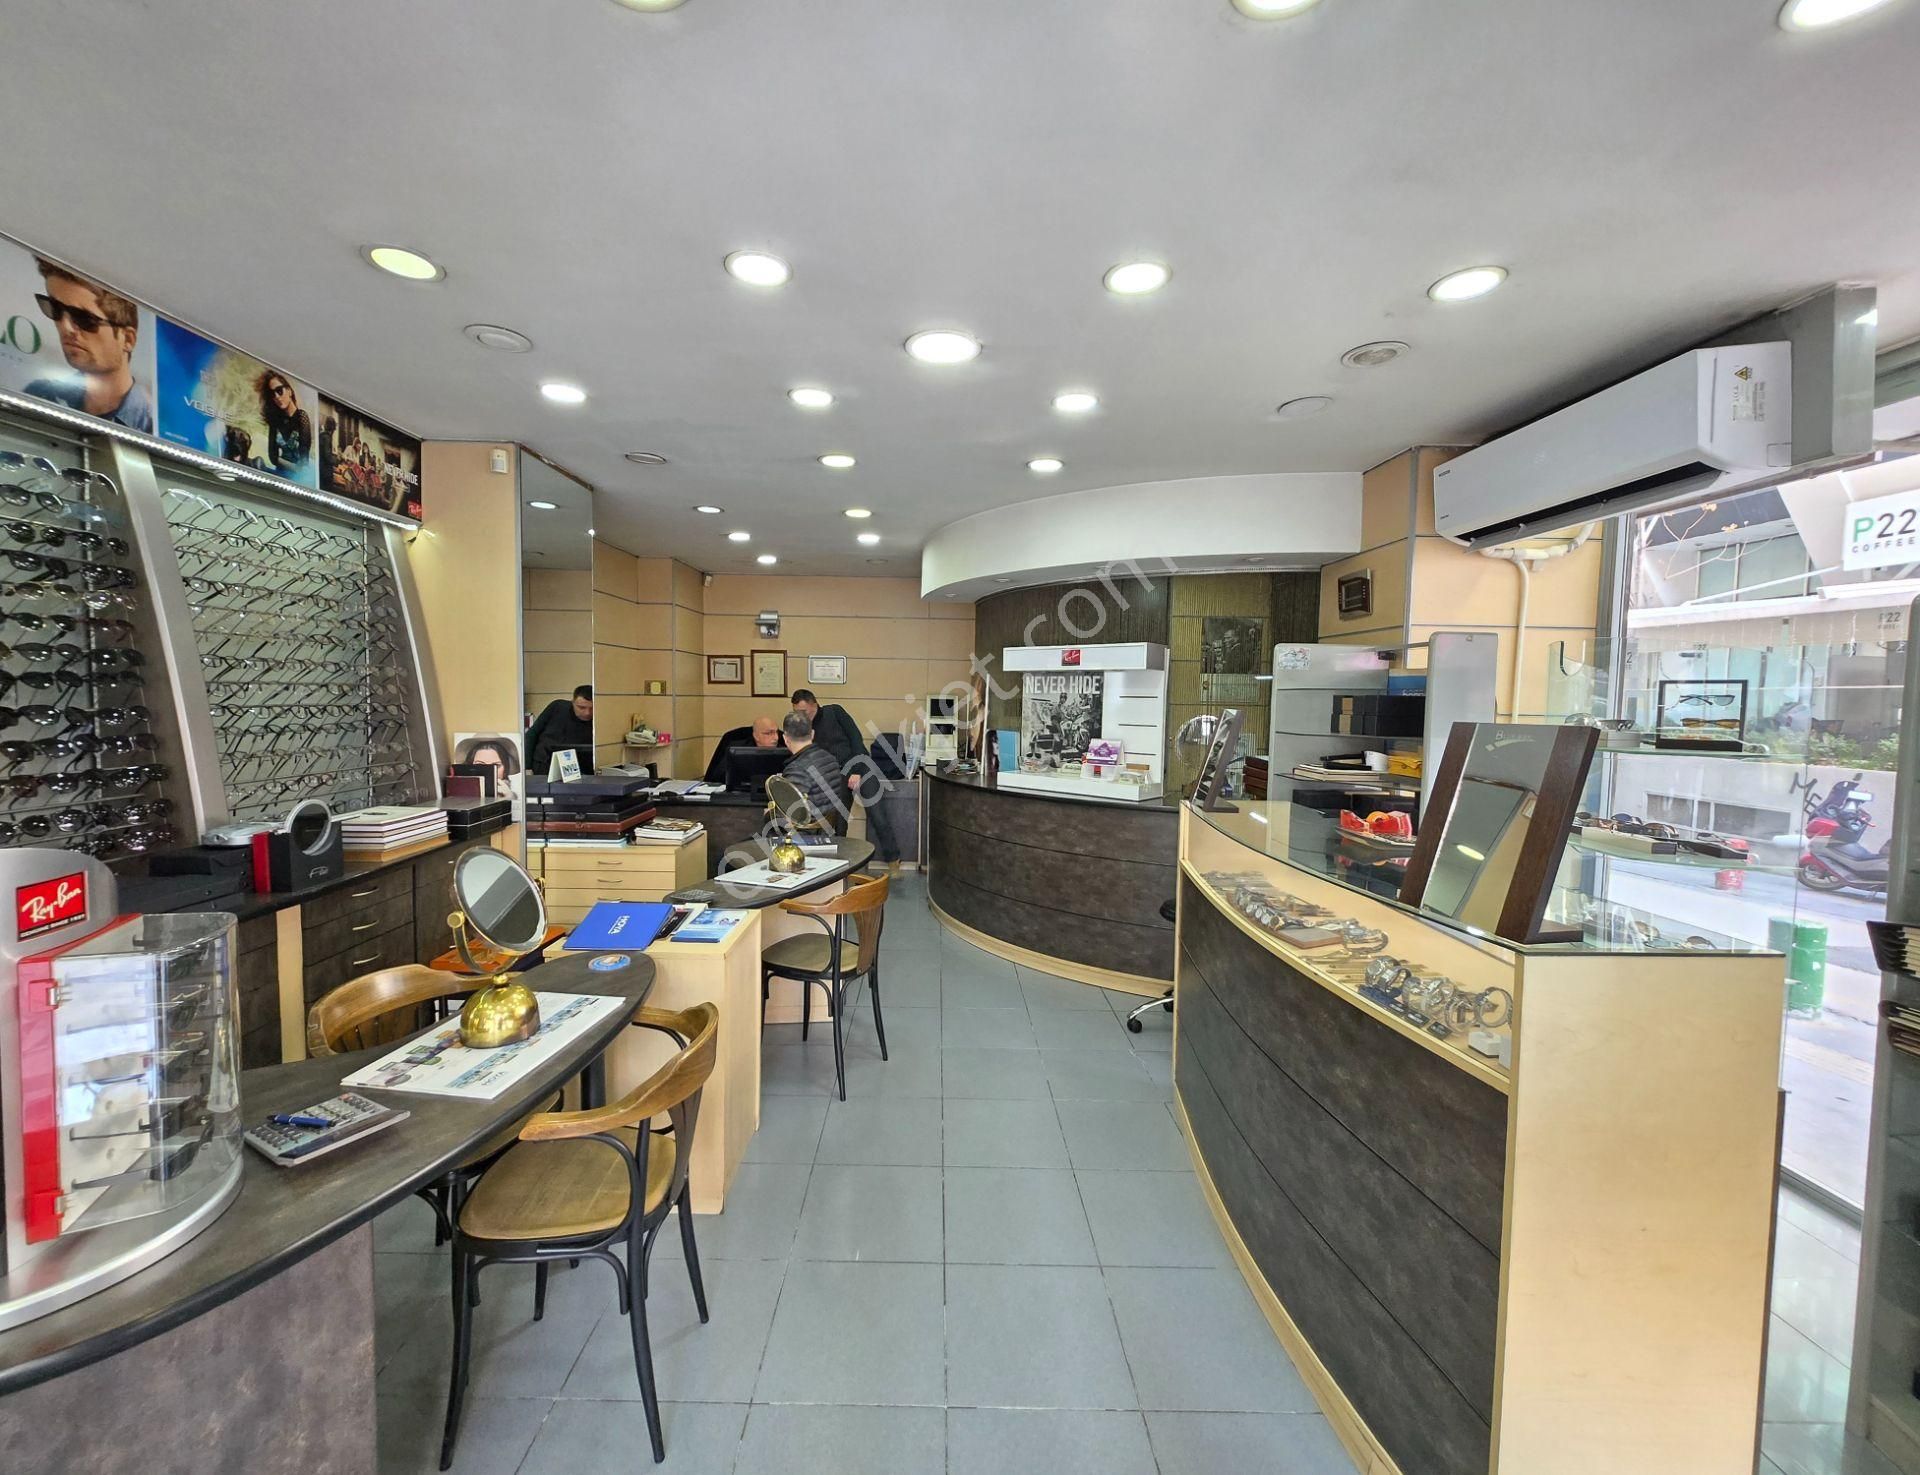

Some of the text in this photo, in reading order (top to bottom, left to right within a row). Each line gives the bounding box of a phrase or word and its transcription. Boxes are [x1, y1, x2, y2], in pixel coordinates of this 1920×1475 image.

[1853, 509, 1917, 543] P22
[1852, 537, 1916, 554] COFFEE
[1025, 675, 1101, 694] NEVER HIDE
[22, 882, 82, 923] Ray-Ban
